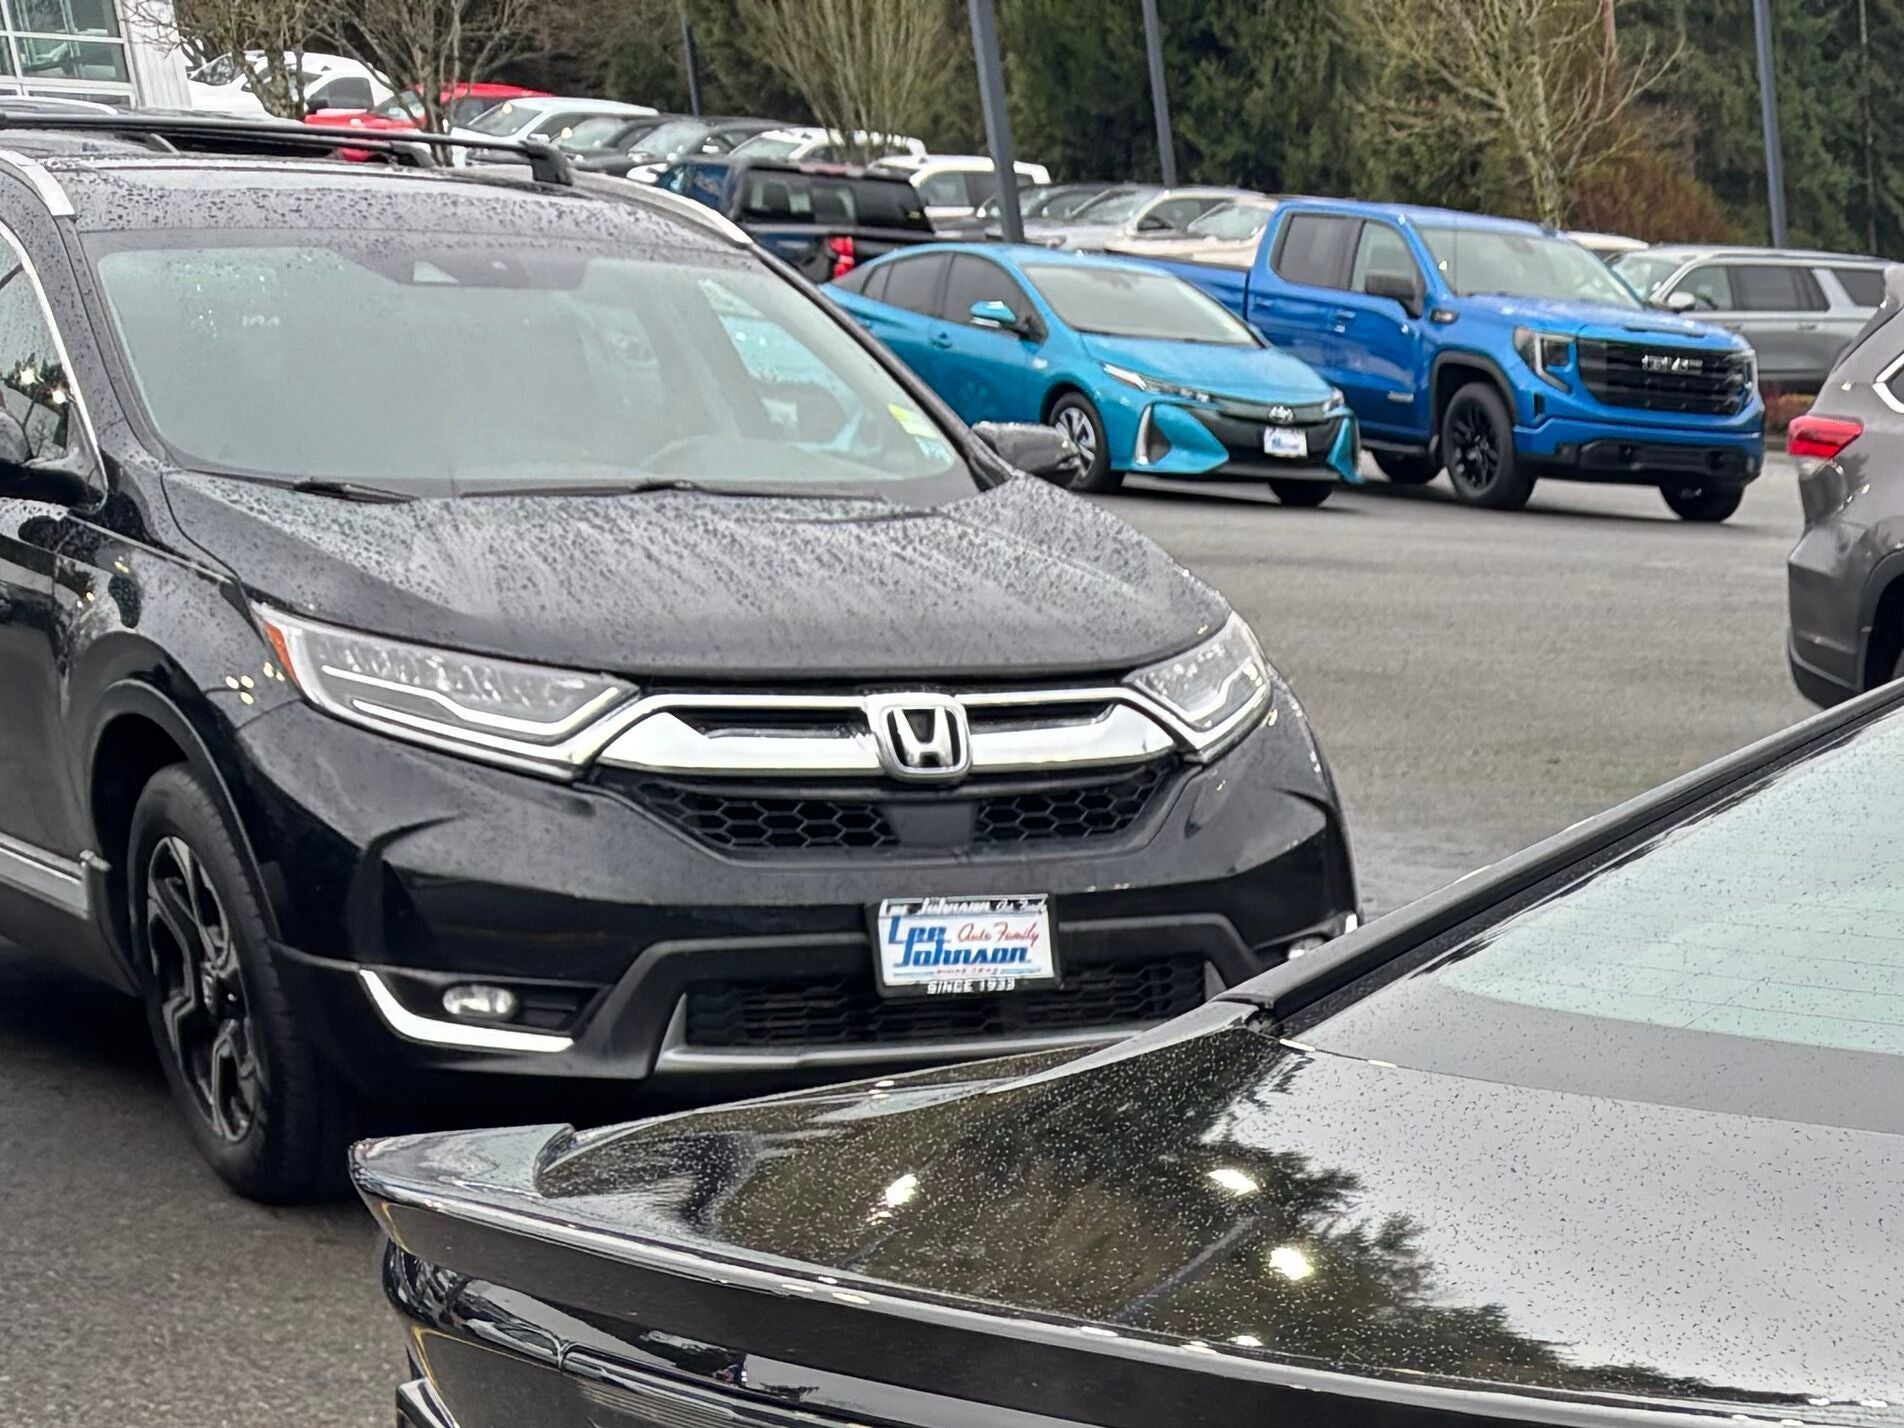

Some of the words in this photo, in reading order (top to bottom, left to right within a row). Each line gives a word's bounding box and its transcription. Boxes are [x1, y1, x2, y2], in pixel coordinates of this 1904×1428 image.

[993, 922, 1041, 947] Family
[893, 929, 1031, 967] Johnson
[927, 980, 973, 994] SINCE
[980, 978, 1016, 992] 1933
